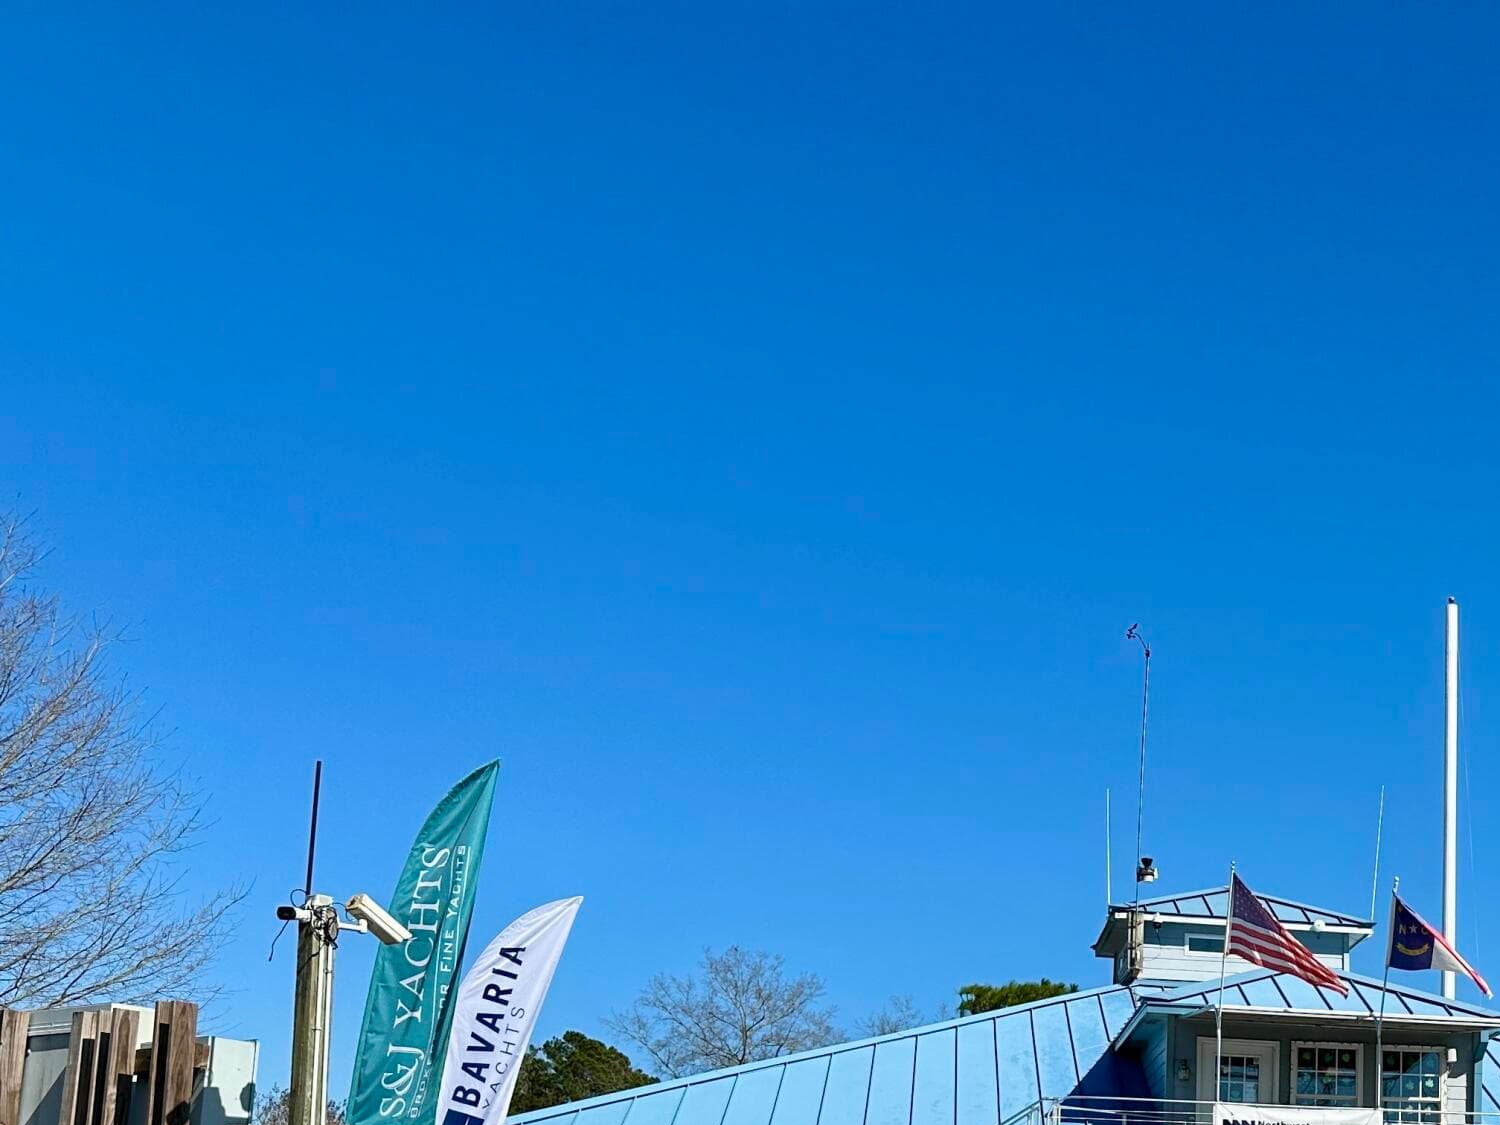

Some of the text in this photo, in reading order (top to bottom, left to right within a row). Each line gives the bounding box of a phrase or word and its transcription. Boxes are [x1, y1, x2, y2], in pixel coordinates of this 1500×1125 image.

[446, 845, 466, 918] YACHTS
[380, 847, 450, 1118] S&J YACHTS
[440, 930, 455, 972] FINE
[451, 946, 527, 1108] BAVARIA
[482, 1006, 525, 1109] YACHTS
